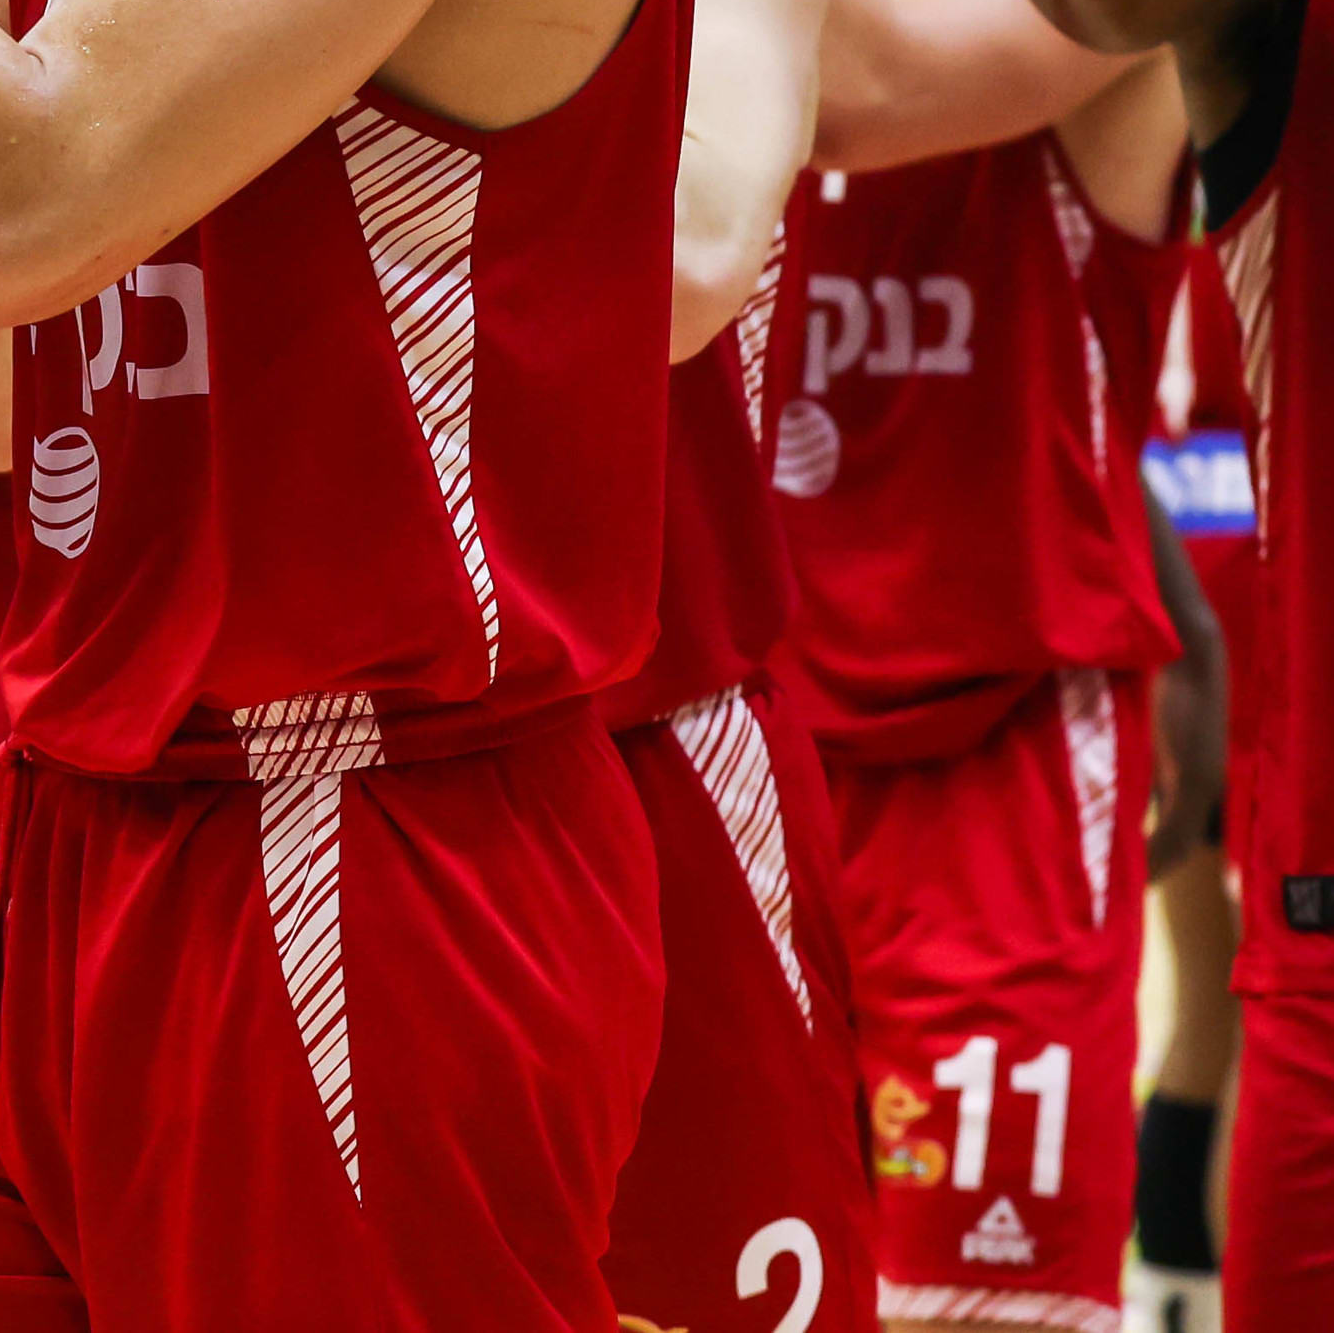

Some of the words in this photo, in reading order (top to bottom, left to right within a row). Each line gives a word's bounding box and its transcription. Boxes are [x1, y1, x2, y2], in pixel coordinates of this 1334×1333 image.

[805, 275, 974, 394] בנק
[932, 1035, 1072, 1199] 11
[735, 1216, 824, 1333] 2
